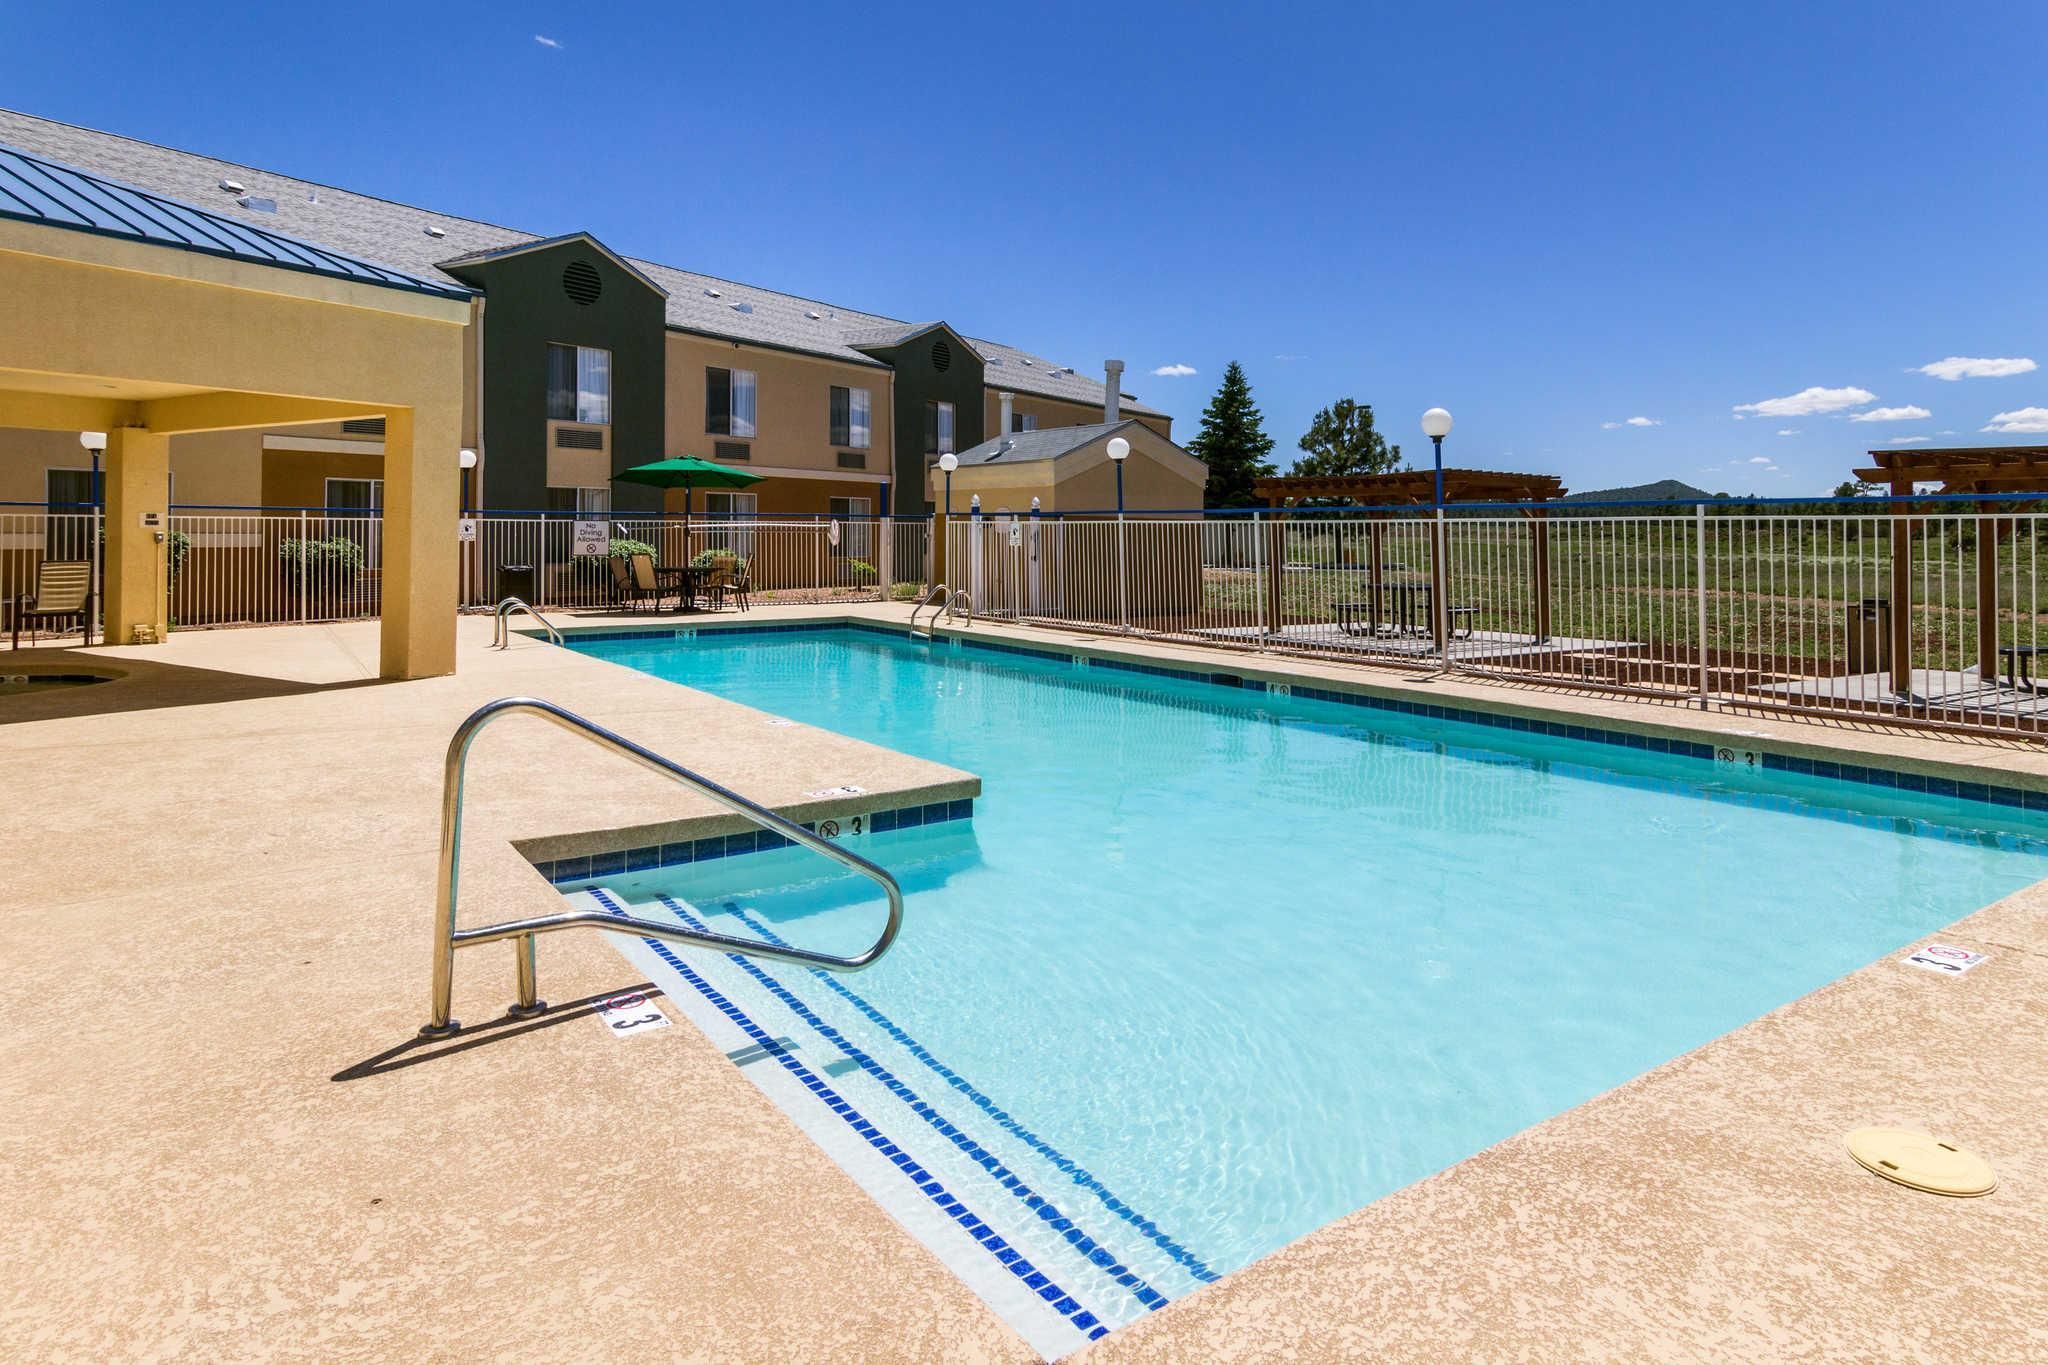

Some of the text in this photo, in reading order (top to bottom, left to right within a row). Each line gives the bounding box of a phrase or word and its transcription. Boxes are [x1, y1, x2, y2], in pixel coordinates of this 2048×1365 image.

[580, 529, 602, 537] Diving
[851, 816, 862, 836] 3
[612, 1013, 662, 1030] 3
